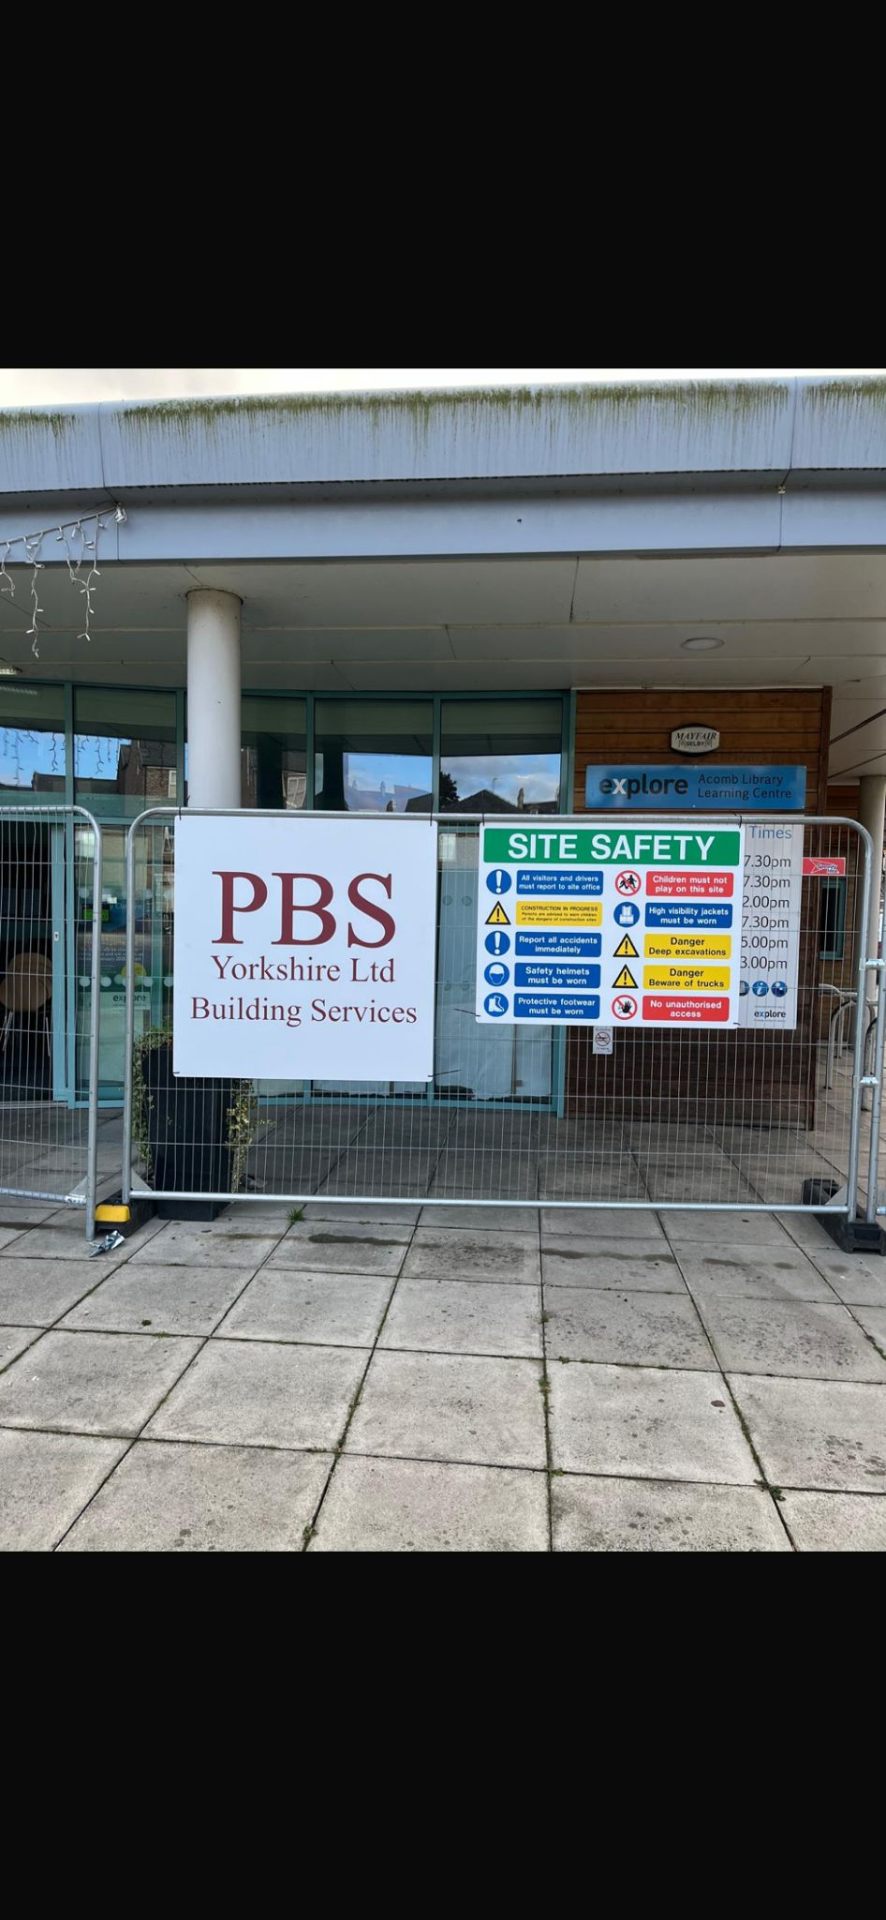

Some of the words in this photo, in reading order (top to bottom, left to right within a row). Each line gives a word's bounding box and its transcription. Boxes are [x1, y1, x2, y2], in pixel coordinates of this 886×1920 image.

[675, 732, 717, 740] MAYFAIR
[600, 773, 689, 799] explore
[698, 774, 739, 785] Acomb
[742, 774, 784, 787] Library
[698, 788, 750, 800] Learning
[752, 788, 792, 799] Centre
[749, 825, 793, 840] Times
[508, 832, 578, 860] SITE
[591, 834, 716, 861] SAFETY
[743, 855, 792, 869] 7.30pm
[533, 874, 557, 882] visitors
[652, 875, 687, 884] Children
[689, 876, 710, 884] must
[743, 875, 791, 889] 7.30pm
[655, 886, 673, 894] play
[211, 871, 396, 949] PBS
[648, 907, 666, 916] High
[668, 907, 698, 916] visibility
[701, 907, 729, 917] jackets
[742, 916, 789, 930] 7.30pm
[519, 935, 545, 945] Report
[560, 936, 598, 944] accidents
[670, 937, 705, 947] Danger
[741, 936, 789, 951] 5.00pm
[535, 945, 581, 954] immediately
[649, 947, 672, 956] Deep
[675, 948, 726, 956] excavations
[740, 956, 788, 971] 3.00pm
[211, 955, 341, 981] Yorkshire
[350, 958, 396, 983] Ltd
[525, 966, 553, 976] Safety
[556, 967, 590, 976] helmets
[669, 968, 705, 978] Danger
[551, 977, 563, 985] be
[649, 979, 681, 987] Beware
[518, 997, 558, 1006] Protective
[560, 998, 596, 1006] footwear
[650, 1000, 663, 1008] No
[665, 1001, 722, 1009] unauthorised
[191, 996, 302, 1028] Building
[311, 998, 417, 1024] Services
[754, 1010, 786, 1019] explore
